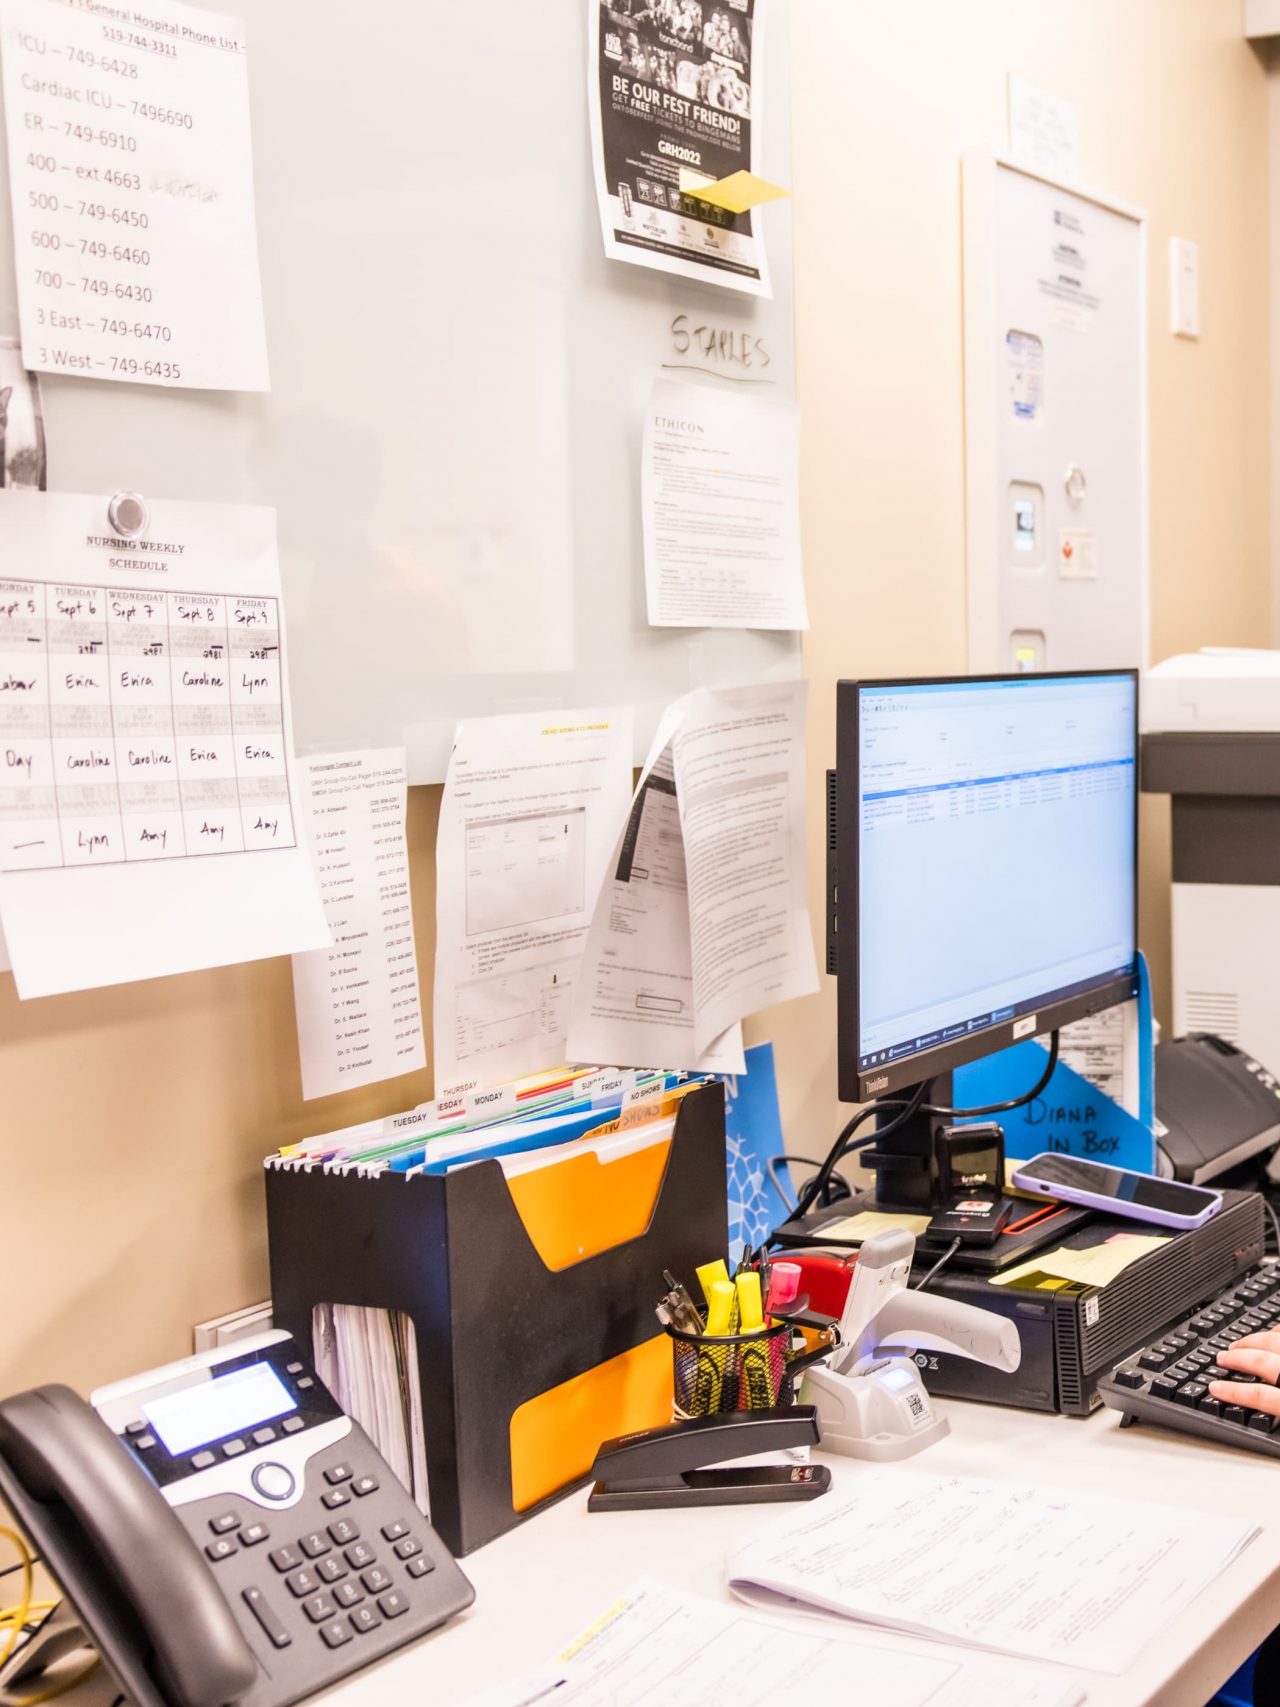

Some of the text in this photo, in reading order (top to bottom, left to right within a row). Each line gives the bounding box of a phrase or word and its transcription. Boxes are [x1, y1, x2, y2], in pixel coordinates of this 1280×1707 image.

[86, 0, 130, 21] General
[134, 12, 179, 36] Hospital
[183, 26, 216, 46] Phone
[220, 36, 238, 50] List
[18, 31, 46, 55] ICU
[67, 46, 139, 79] 749-6428
[102, 26, 177, 56] 519-744-3311
[21, 72, 81, 102] Cardiac
[86, 90, 112, 109] ICU
[131, 101, 193, 129] 7496690
[612, 75, 740, 135] BE OUR FEST FRIEND!
[612, 92, 628, 104] GET
[630, 98, 651, 113] FREE
[652, 105, 683, 124] TICKETS
[24, 112, 44, 132] ER
[64, 121, 137, 152] 749-6910
[658, 140, 701, 166] GRH2022
[27, 153, 57, 173] 400
[76, 165, 101, 182] ext
[104, 170, 141, 191] 4663
[29, 191, 59, 212] 500
[78, 201, 149, 229] 749-6450
[31, 231, 61, 251] 600
[80, 239, 151, 266] 749-6460
[34, 269, 62, 289] 700
[81, 277, 153, 303] 749-6430
[37, 308, 45, 325] 3
[50, 311, 82, 330] East
[100, 318, 172, 342] 749-6470
[671, 315, 770, 368] STAPLES
[40, 348, 48, 364] 3
[52, 350, 92, 370] West
[110, 356, 181, 379] 749-6435
[654, 416, 705, 433] ETHICON
[86, 535, 185, 555] NURSING WEEKLY
[109, 558, 169, 572] SCHEDULE
[0, 601, 18, 618] ept
[27, 600, 36, 613] 5
[57, 600, 82, 618] Sept
[144, 604, 154, 617] 7
[206, 608, 215, 621] 8
[261, 612, 268, 623] 9
[54, 586, 98, 598] TUESDAY
[108, 591, 164, 602] WEDNESDAY
[173, 595, 220, 606] THURSDAY
[236, 599, 267, 609] FRIDAY
[120, 672, 154, 688] Erica
[182, 671, 224, 688] Caroline
[242, 674, 269, 694] Lynn
[6, 750, 32, 779] Day
[67, 751, 111, 768] Caroline
[128, 749, 173, 767] Caroline
[190, 748, 218, 762] Erica
[78, 817, 279, 854] Lynn Amy Amy Amy
[443, 1081, 478, 1097] THURSDAY
[474, 1091, 504, 1105] MONDAY
[601, 1079, 623, 1092] FRIDAY
[631, 1084, 661, 1101] NO SHOWS
[392, 1113, 427, 1128] TUESDAY
[1023, 1094, 1097, 1126] DIANA
[1048, 1136, 1070, 1153] IN
[310, 1535, 321, 1546] 2
[338, 1522, 349, 1533] 3
[327, 1559, 337, 1571] 5
[355, 1546, 366, 1557] 6
[314, 1570, 382, 1609] 7 8 9
[361, 1610, 371, 1620] 0
